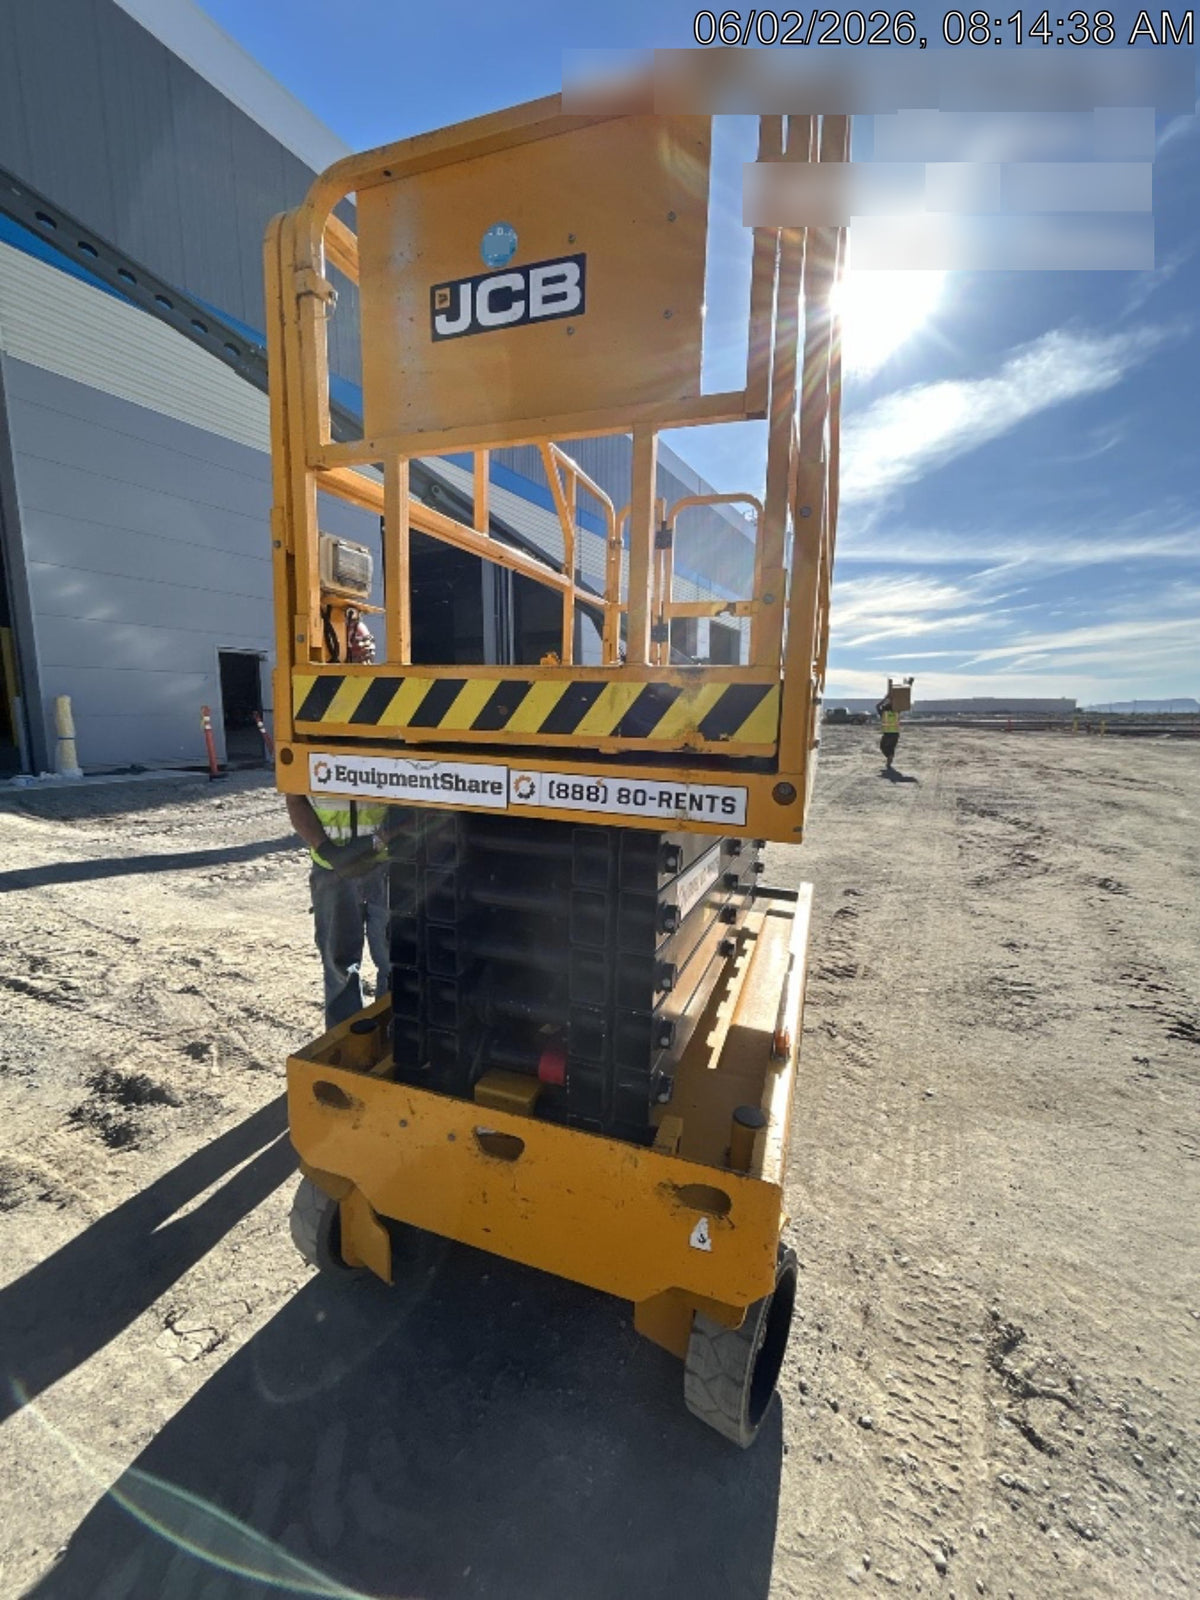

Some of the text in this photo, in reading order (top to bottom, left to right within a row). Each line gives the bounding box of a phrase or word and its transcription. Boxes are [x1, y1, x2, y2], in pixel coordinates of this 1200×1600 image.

[435, 262, 581, 335] JCB
[335, 764, 503, 795] EquipmentShare
[548, 780, 736, 815] (888) 80-RENTS
